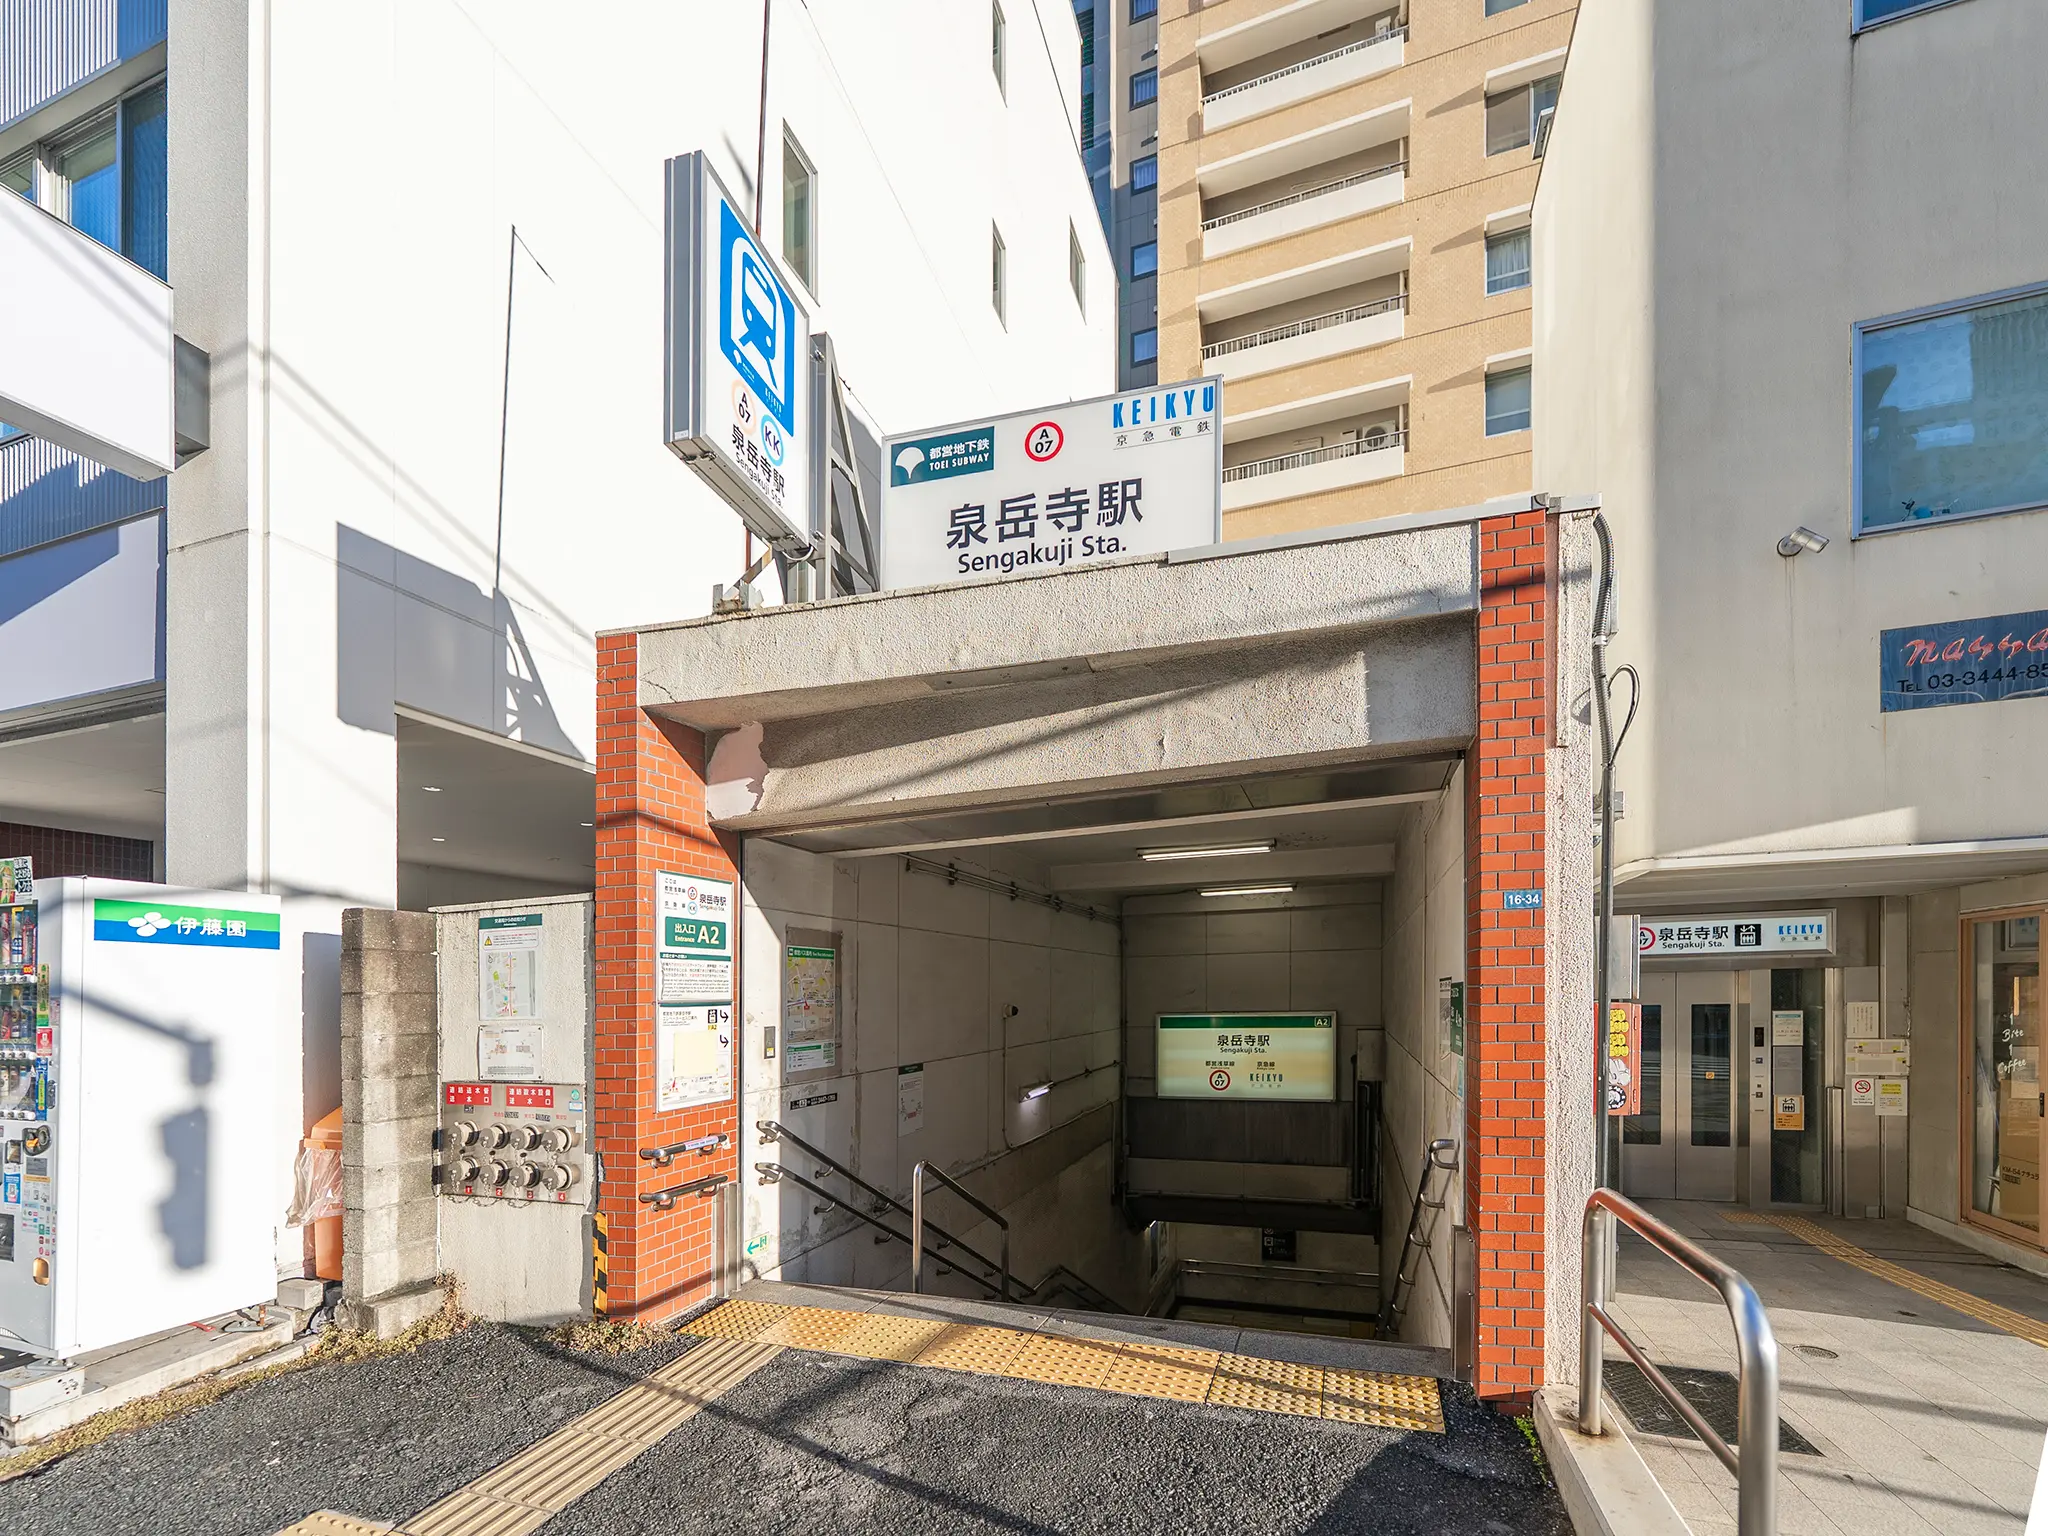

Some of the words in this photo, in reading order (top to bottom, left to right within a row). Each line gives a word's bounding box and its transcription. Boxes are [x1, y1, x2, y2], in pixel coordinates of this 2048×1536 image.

[741, 392, 748, 406] A
[738, 403, 751, 423] 07
[1113, 385, 1215, 428] KEIKYU
[1039, 428, 1050, 440] A
[1116, 420, 1211, 447] 京急電鉄
[764, 425, 781, 457] KK
[1035, 440, 1053, 454] 07
[929, 438, 990, 460] 都営地下鉄
[731, 423, 785, 498] 泉岳寺駅
[929, 459, 949, 472] TOEI
[951, 452, 990, 468] SUBWAY
[946, 477, 1144, 550] 泉岳寺駅
[958, 538, 1074, 574] Sengakuji
[1081, 535, 1127, 557] Sta.
[1897, 679, 1922, 693] TEL
[1508, 893, 1540, 905] 16-34
[173, 916, 247, 938] 伊藤園
[674, 922, 696, 934] 出入口
[1658, 925, 1729, 942] 泉岳寺駅
[1778, 923, 1823, 935] KEIKYU
[697, 925, 720, 945] A2
[1662, 940, 1706, 950] Sengakuji
[1708, 940, 1725, 948] Sta.
[1316, 1018, 1329, 1026] A2
[1217, 1034, 1270, 1047] 泉岳寺駅
[2001, 1028, 2024, 1042] Bite
[1220, 1047, 1253, 1055] Sengakuji
[1997, 1058, 2027, 1074] Coffee
[1214, 1079, 1226, 1087] 07
[1249, 1073, 1284, 1082] KEIKYU
